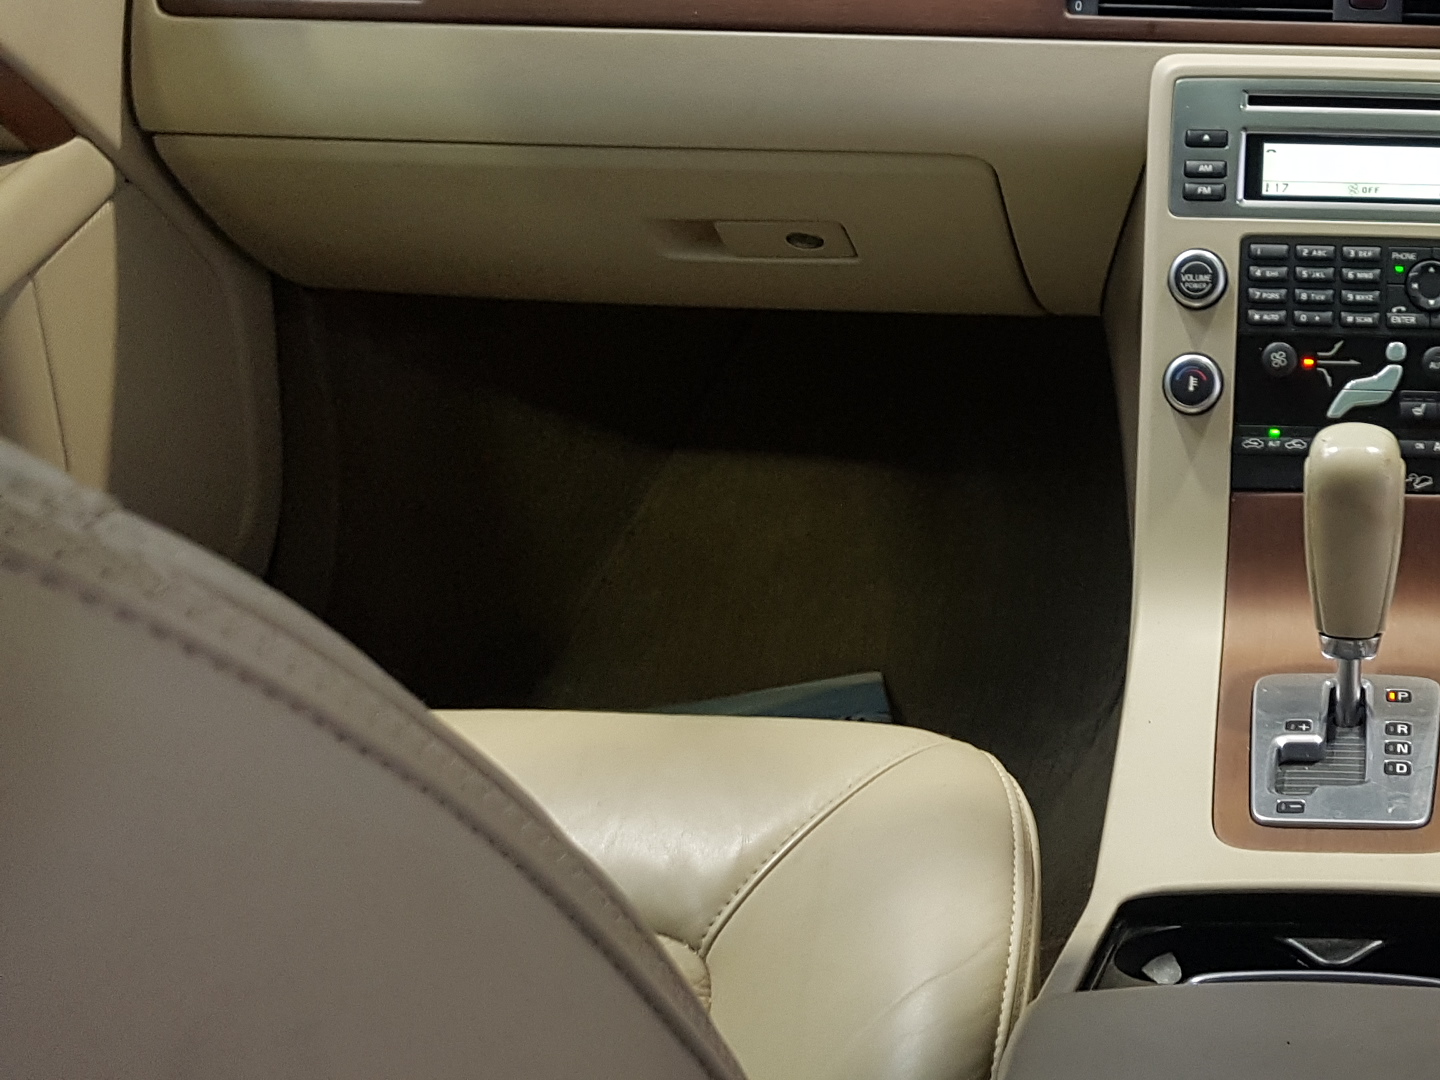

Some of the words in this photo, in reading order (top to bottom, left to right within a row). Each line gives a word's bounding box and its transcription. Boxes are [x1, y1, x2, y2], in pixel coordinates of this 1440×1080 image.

[1391, 251, 1417, 260] PHONE
[1181, 273, 1212, 282] VOLUME
[1397, 692, 1409, 701] P
[1397, 724, 1409, 734] R
[1396, 744, 1409, 754] N
[1395, 764, 1408, 773] D
